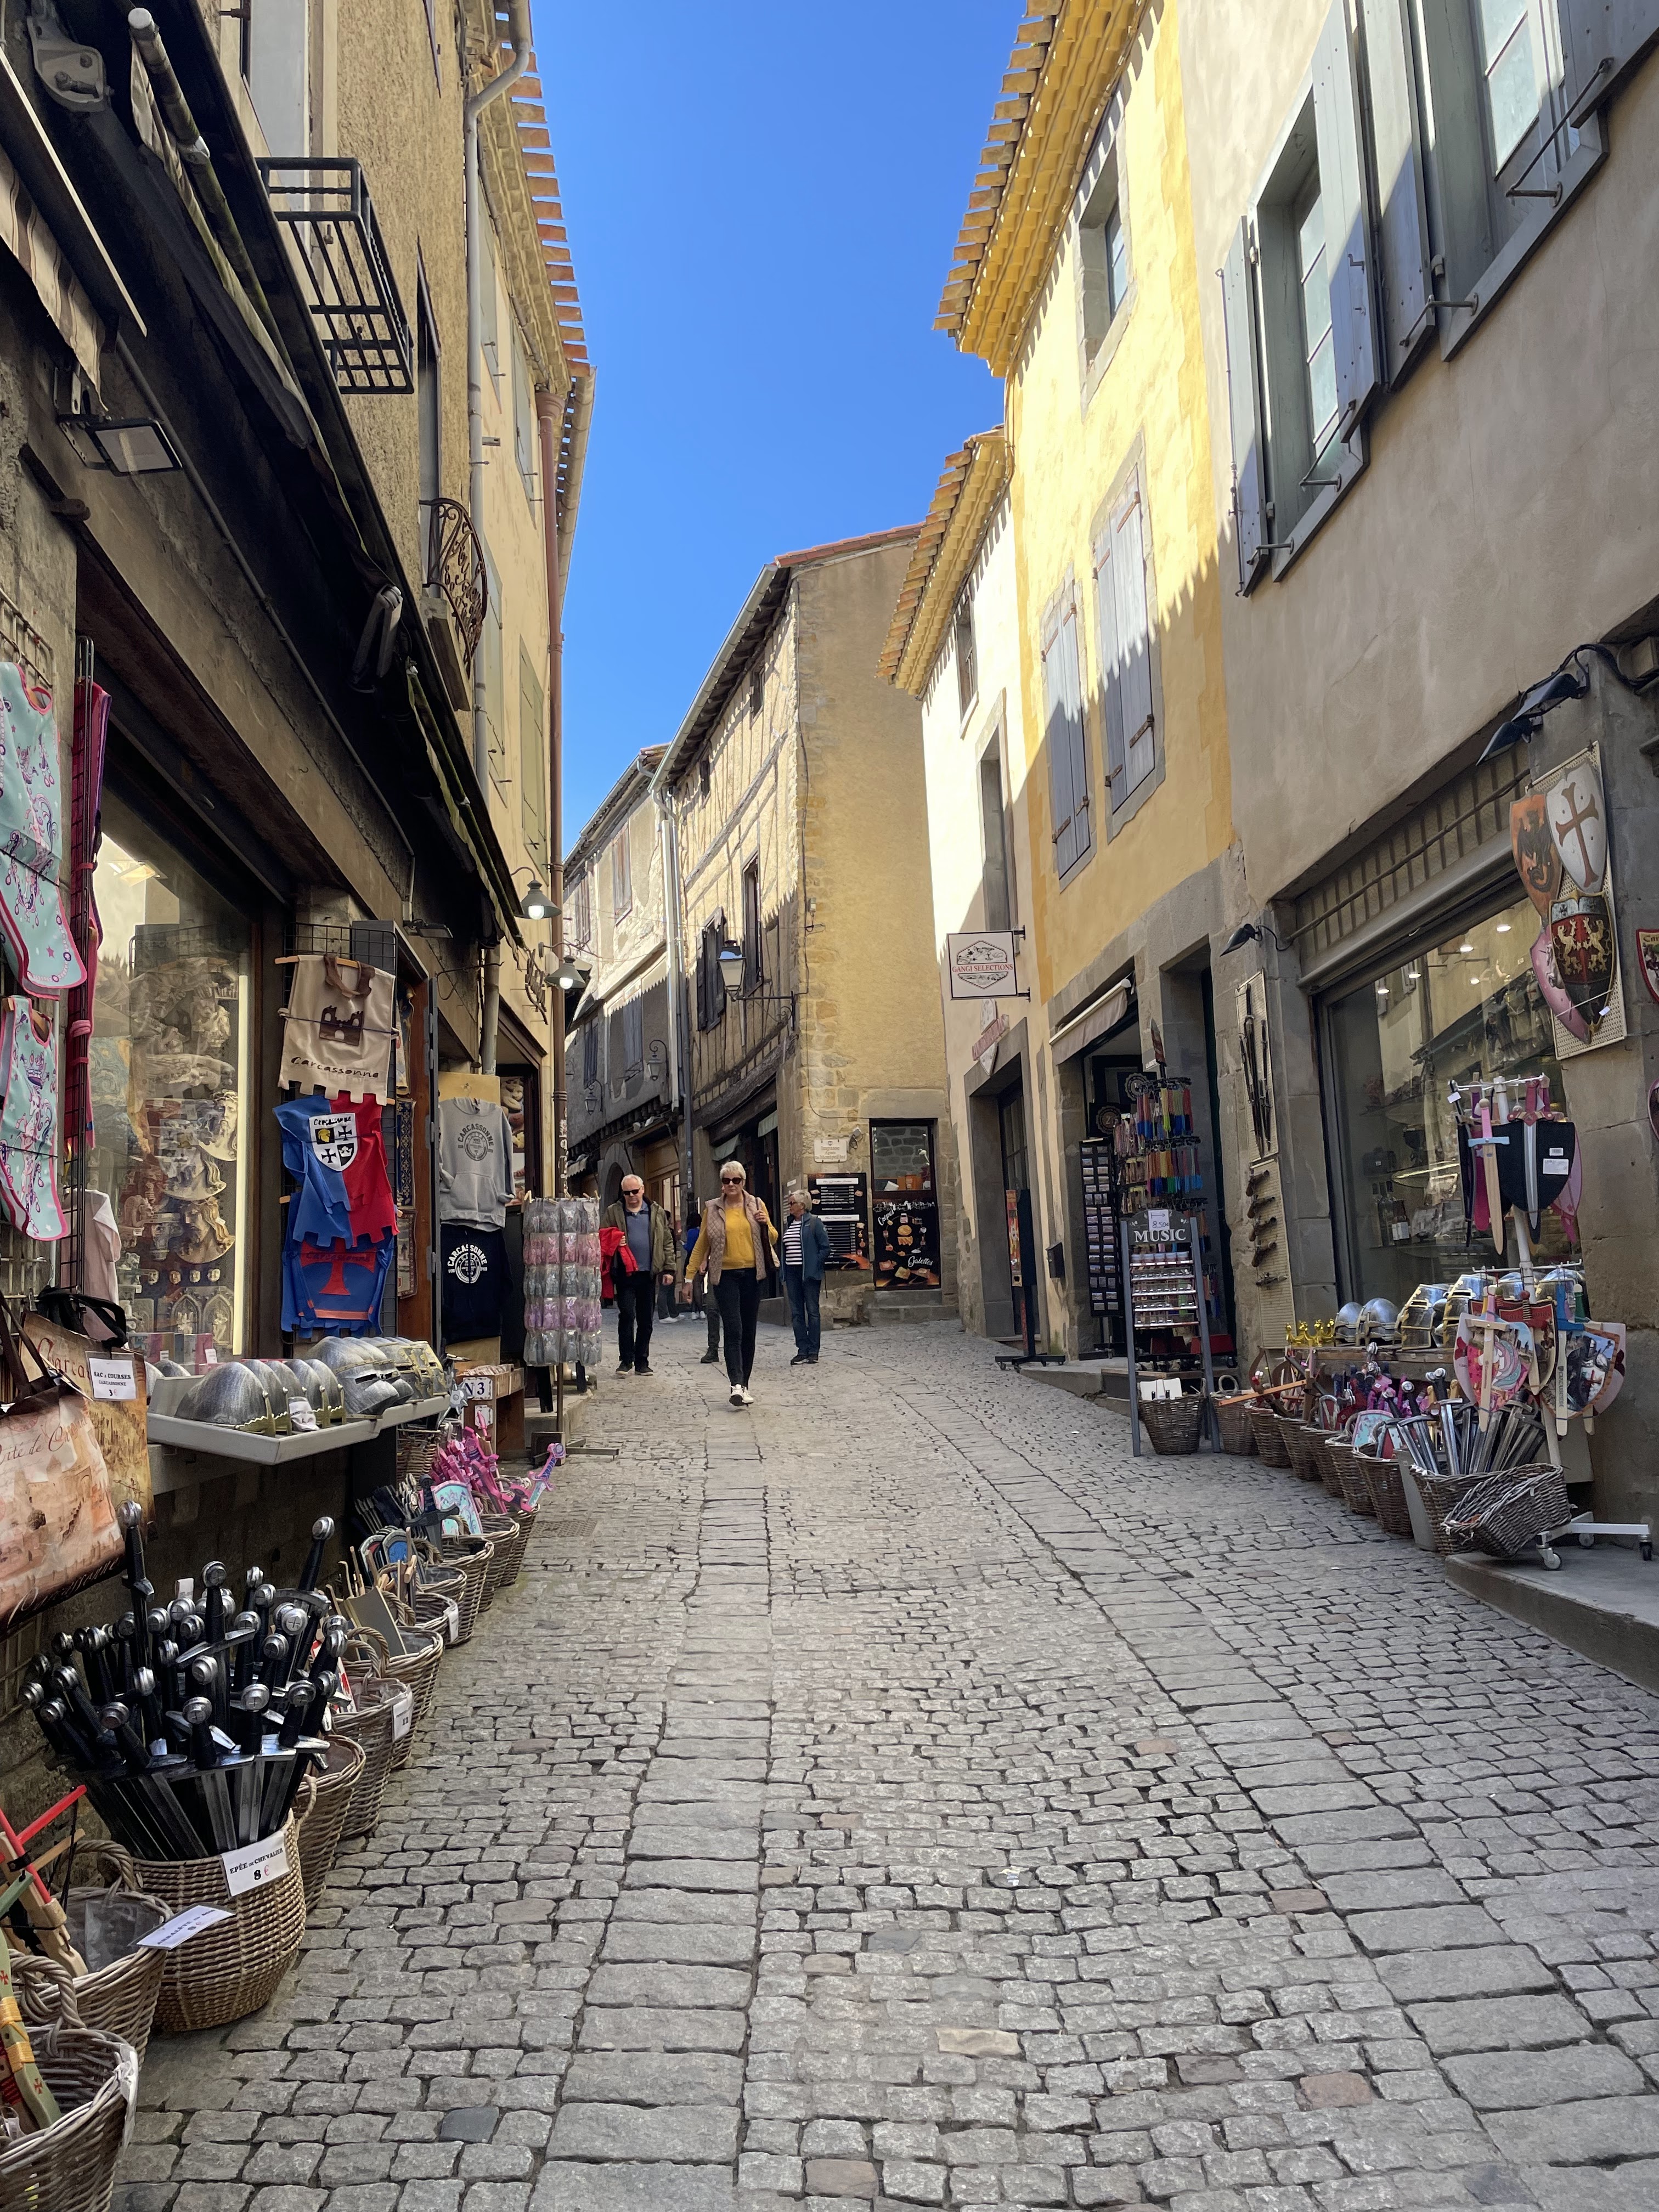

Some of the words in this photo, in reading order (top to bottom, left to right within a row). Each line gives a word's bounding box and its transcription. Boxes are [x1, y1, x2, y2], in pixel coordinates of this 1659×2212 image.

[458, 1123, 494, 1146] CARCASSONNE
[1133, 1229, 1186, 1243] MUSIC
[477, 1382, 485, 1395] 3
[254, 1848, 284, 1864] CHEVALIER
[253, 1870, 262, 1880] 8
